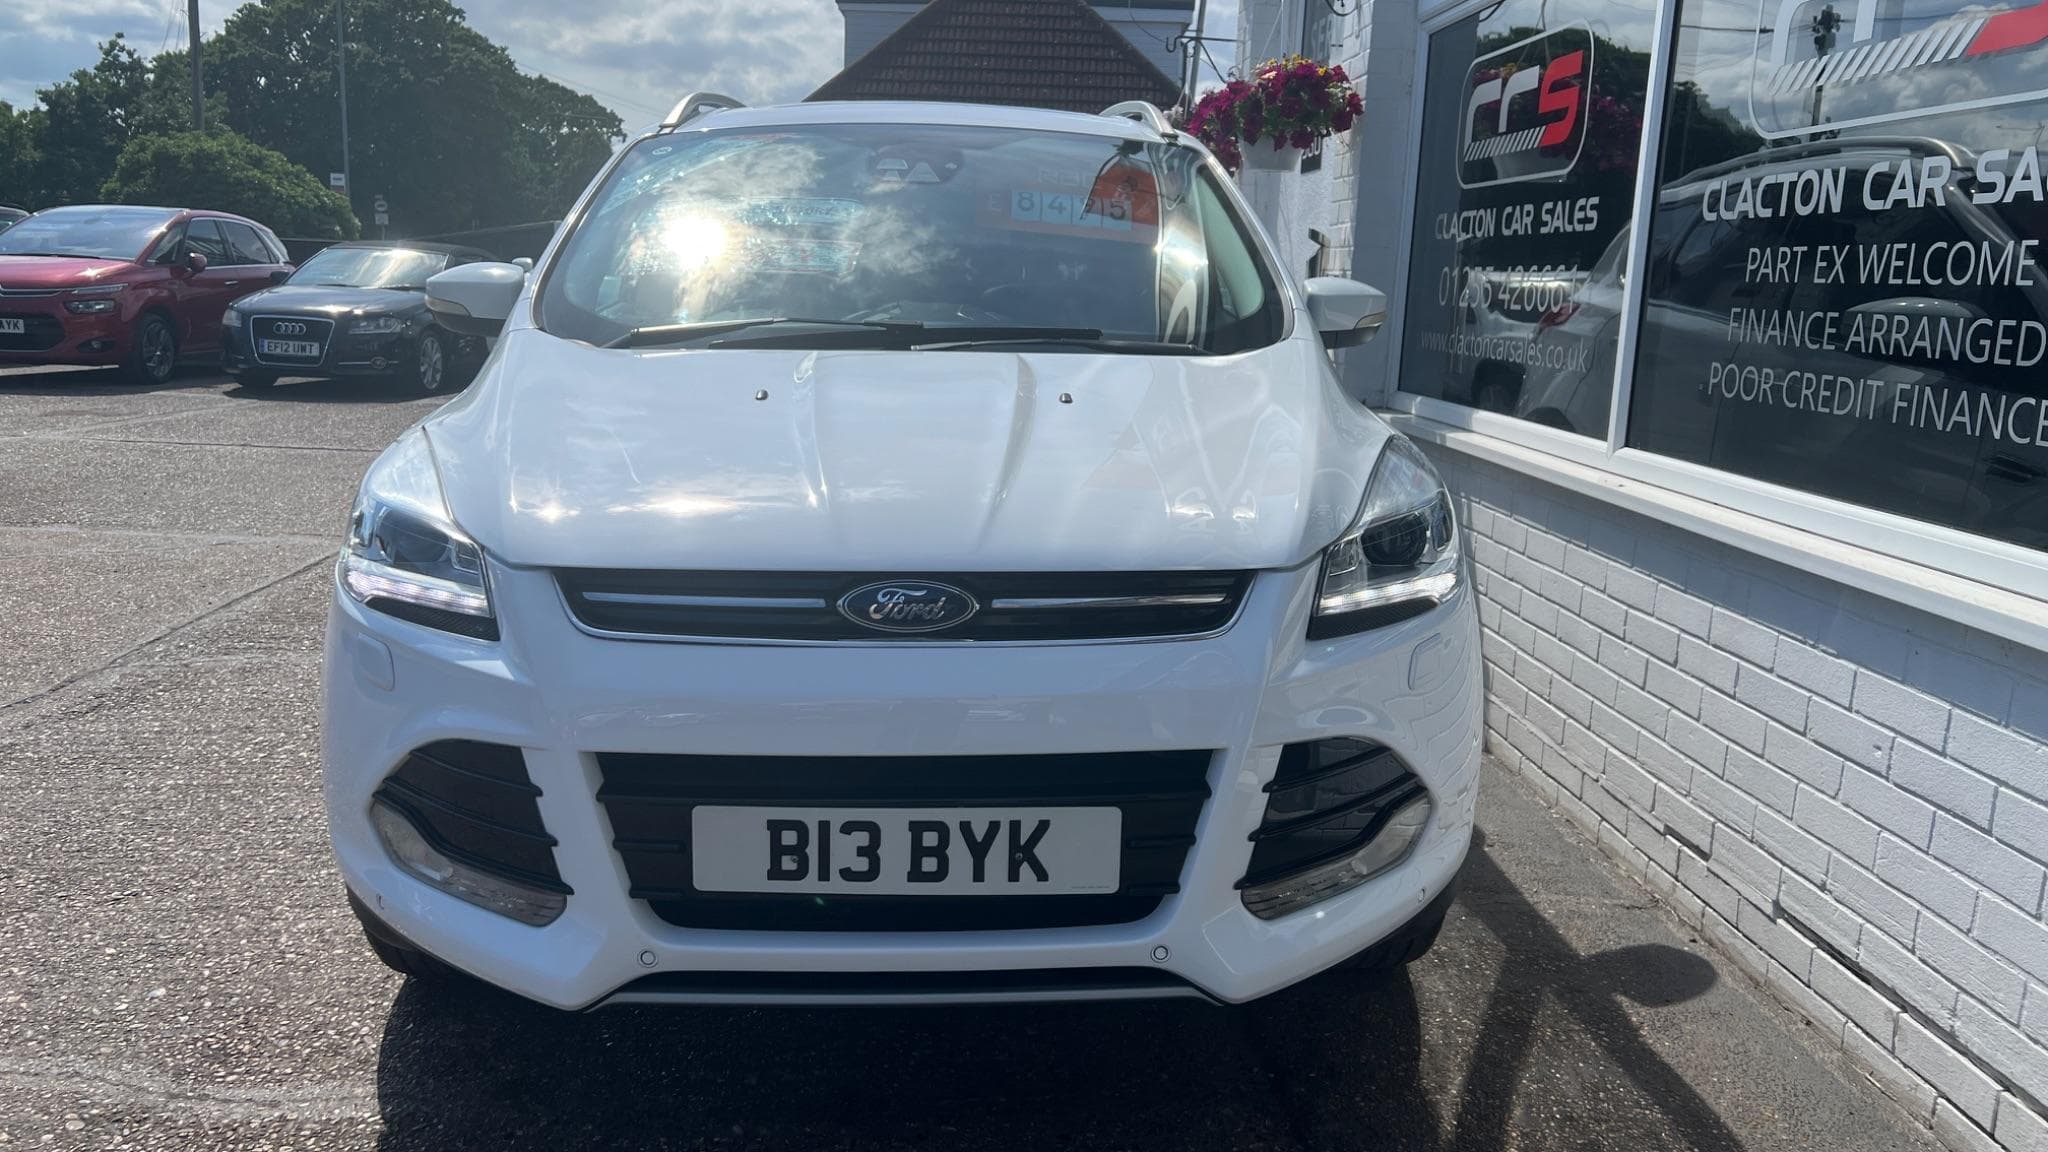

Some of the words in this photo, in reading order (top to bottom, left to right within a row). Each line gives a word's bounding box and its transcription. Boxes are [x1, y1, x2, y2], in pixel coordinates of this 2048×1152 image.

[1702, 165, 1846, 222] CLACTON
[1863, 154, 1951, 211] CAR
[1972, 146, 2048, 205] SA
[1435, 207, 1497, 242] CLACTON
[1502, 203, 1534, 236] CAR
[1540, 196, 1599, 233] SALES
[1745, 245, 1808, 283] PART
[1813, 244, 1849, 284] EX
[1859, 239, 2040, 286] WELCOME
[1727, 307, 1840, 351] FINANCE
[1844, 313, 2048, 368] ARRANGED
[1707, 361, 1774, 405] POOR
[1782, 370, 1886, 421] CREDIT
[868, 587, 947, 621] Ford
[906, 819, 1051, 883] BYK
